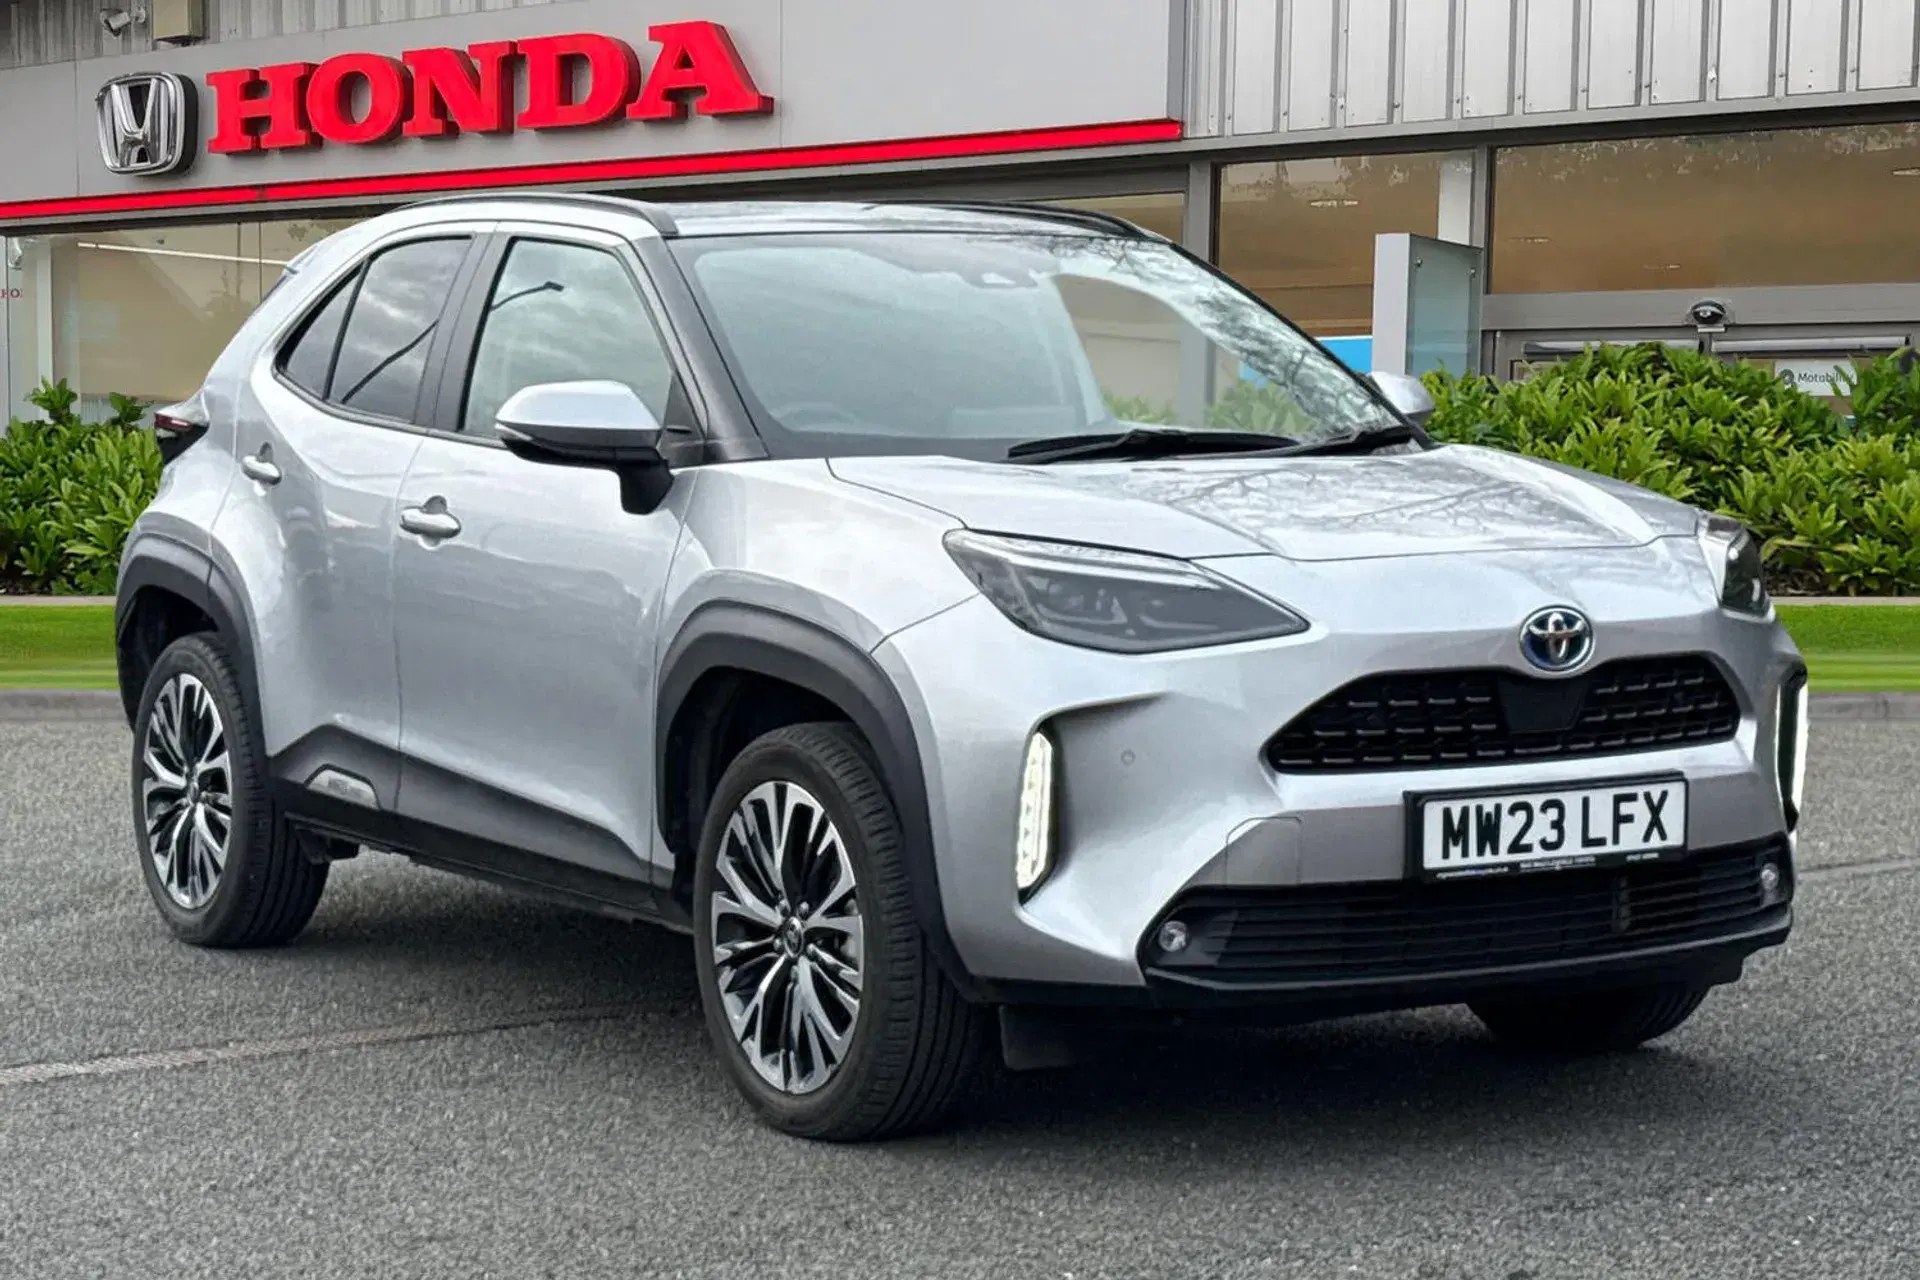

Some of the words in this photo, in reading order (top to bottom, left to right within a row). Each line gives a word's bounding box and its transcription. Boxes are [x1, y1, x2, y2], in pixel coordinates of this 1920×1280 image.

[206, 20, 774, 155] HONDA
[1441, 798, 1566, 860] MW23
[1581, 790, 1669, 848] LFX
